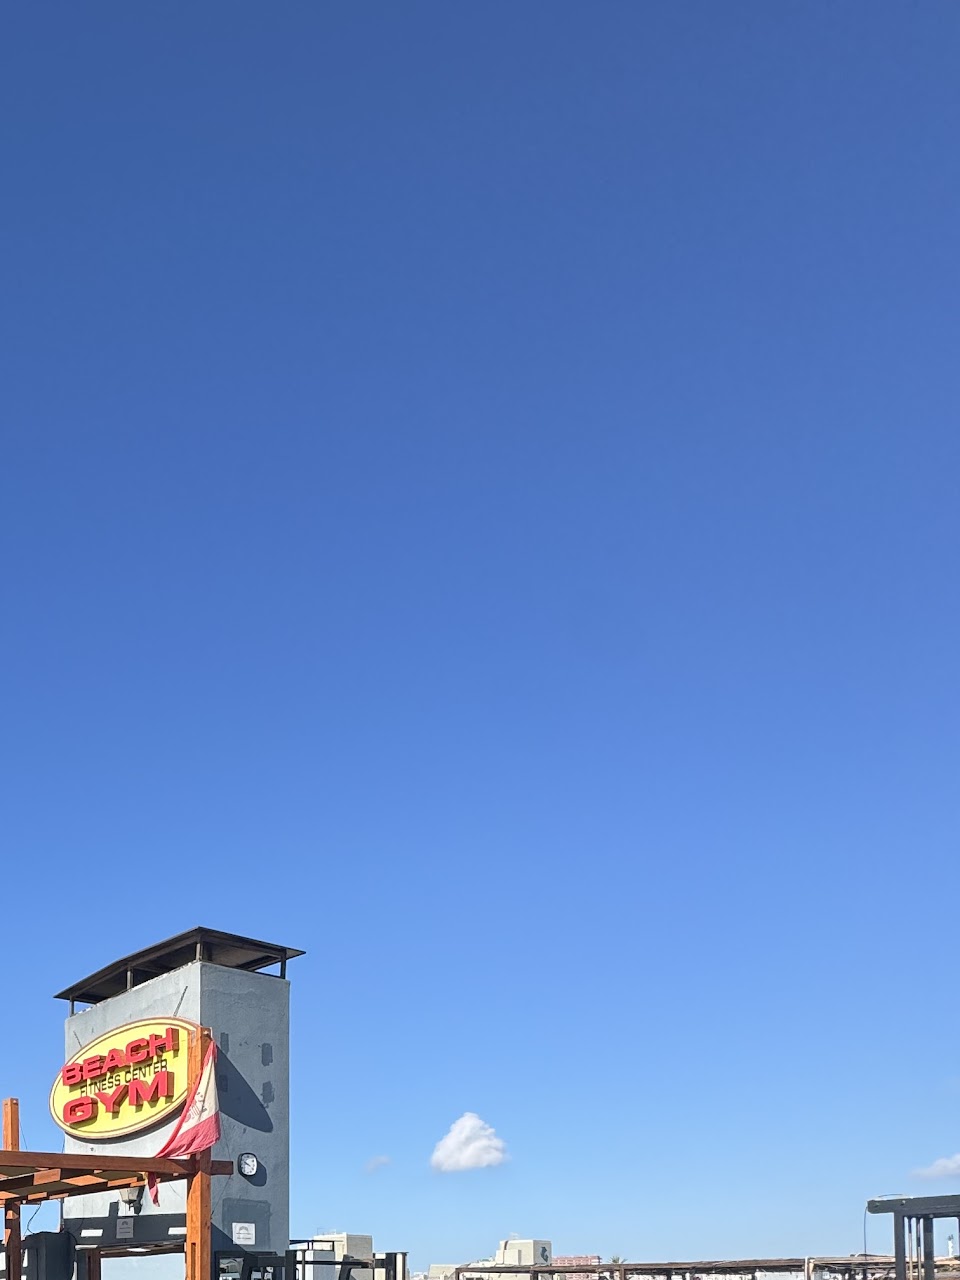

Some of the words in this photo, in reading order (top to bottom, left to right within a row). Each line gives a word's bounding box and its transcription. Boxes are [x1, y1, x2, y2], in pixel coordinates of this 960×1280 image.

[62, 1027, 176, 1087] BEACH
[80, 1074, 121, 1096] FITNESS
[124, 1059, 168, 1082] CENTER
[63, 1070, 171, 1124] GYM
